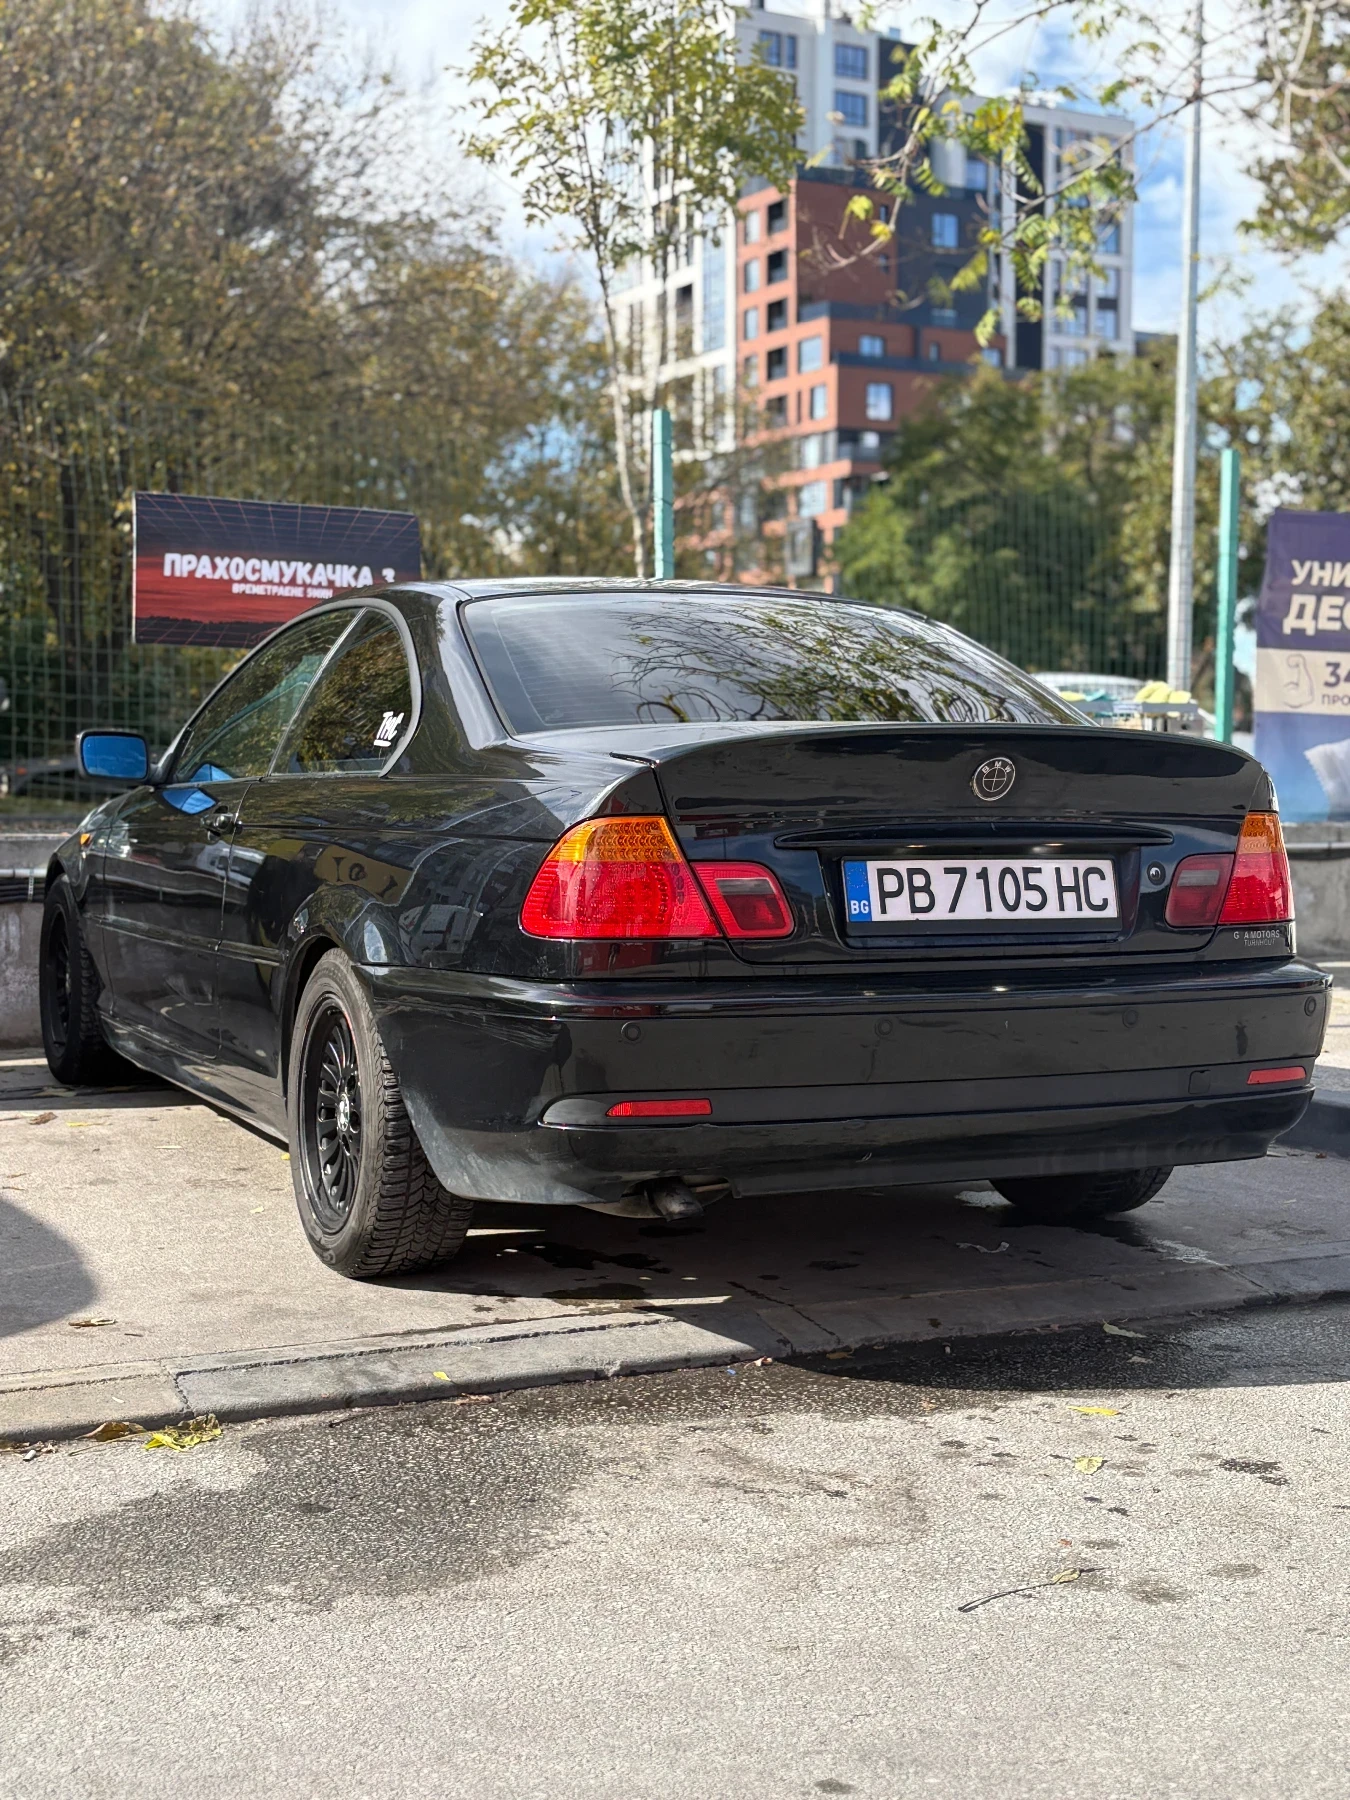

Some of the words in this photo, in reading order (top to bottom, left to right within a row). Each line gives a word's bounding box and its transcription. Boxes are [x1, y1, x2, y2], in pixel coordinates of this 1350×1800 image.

[163, 552, 373, 588] ПРАХОСМУКАЧКА
[232, 583, 305, 597] ВРЕМЕТРАЕНЕ
[981, 760, 1012, 774] BMW
[876, 867, 936, 915] PB
[943, 866, 1048, 913] 7105
[1054, 866, 1109, 912] HC
[850, 900, 870, 914] BG
